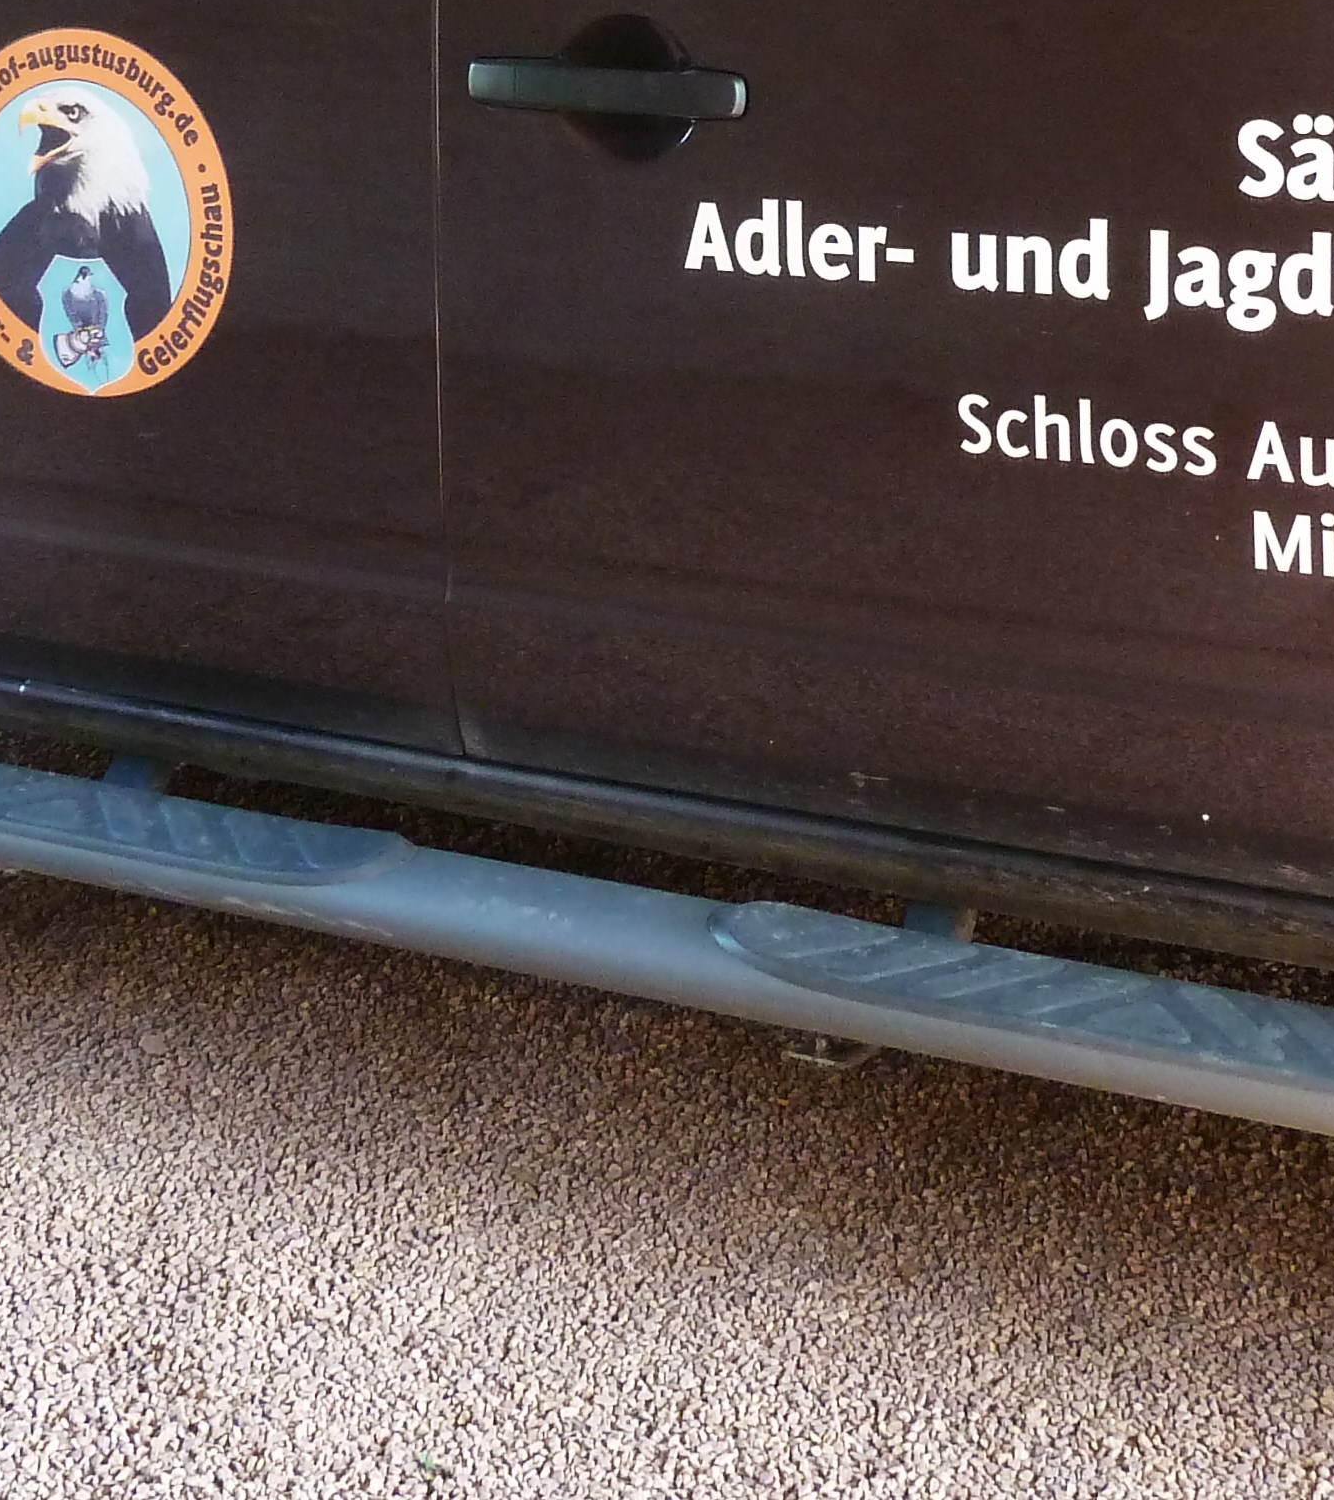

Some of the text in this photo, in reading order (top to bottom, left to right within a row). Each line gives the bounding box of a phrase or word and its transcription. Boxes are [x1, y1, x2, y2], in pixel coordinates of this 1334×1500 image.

[15, 338, 36, 367] &
[137, 181, 224, 376] Geierflugschau
[684, 198, 915, 283] Adler-
[951, 218, 1111, 301] und
[957, 392, 1217, 477] Schloss
